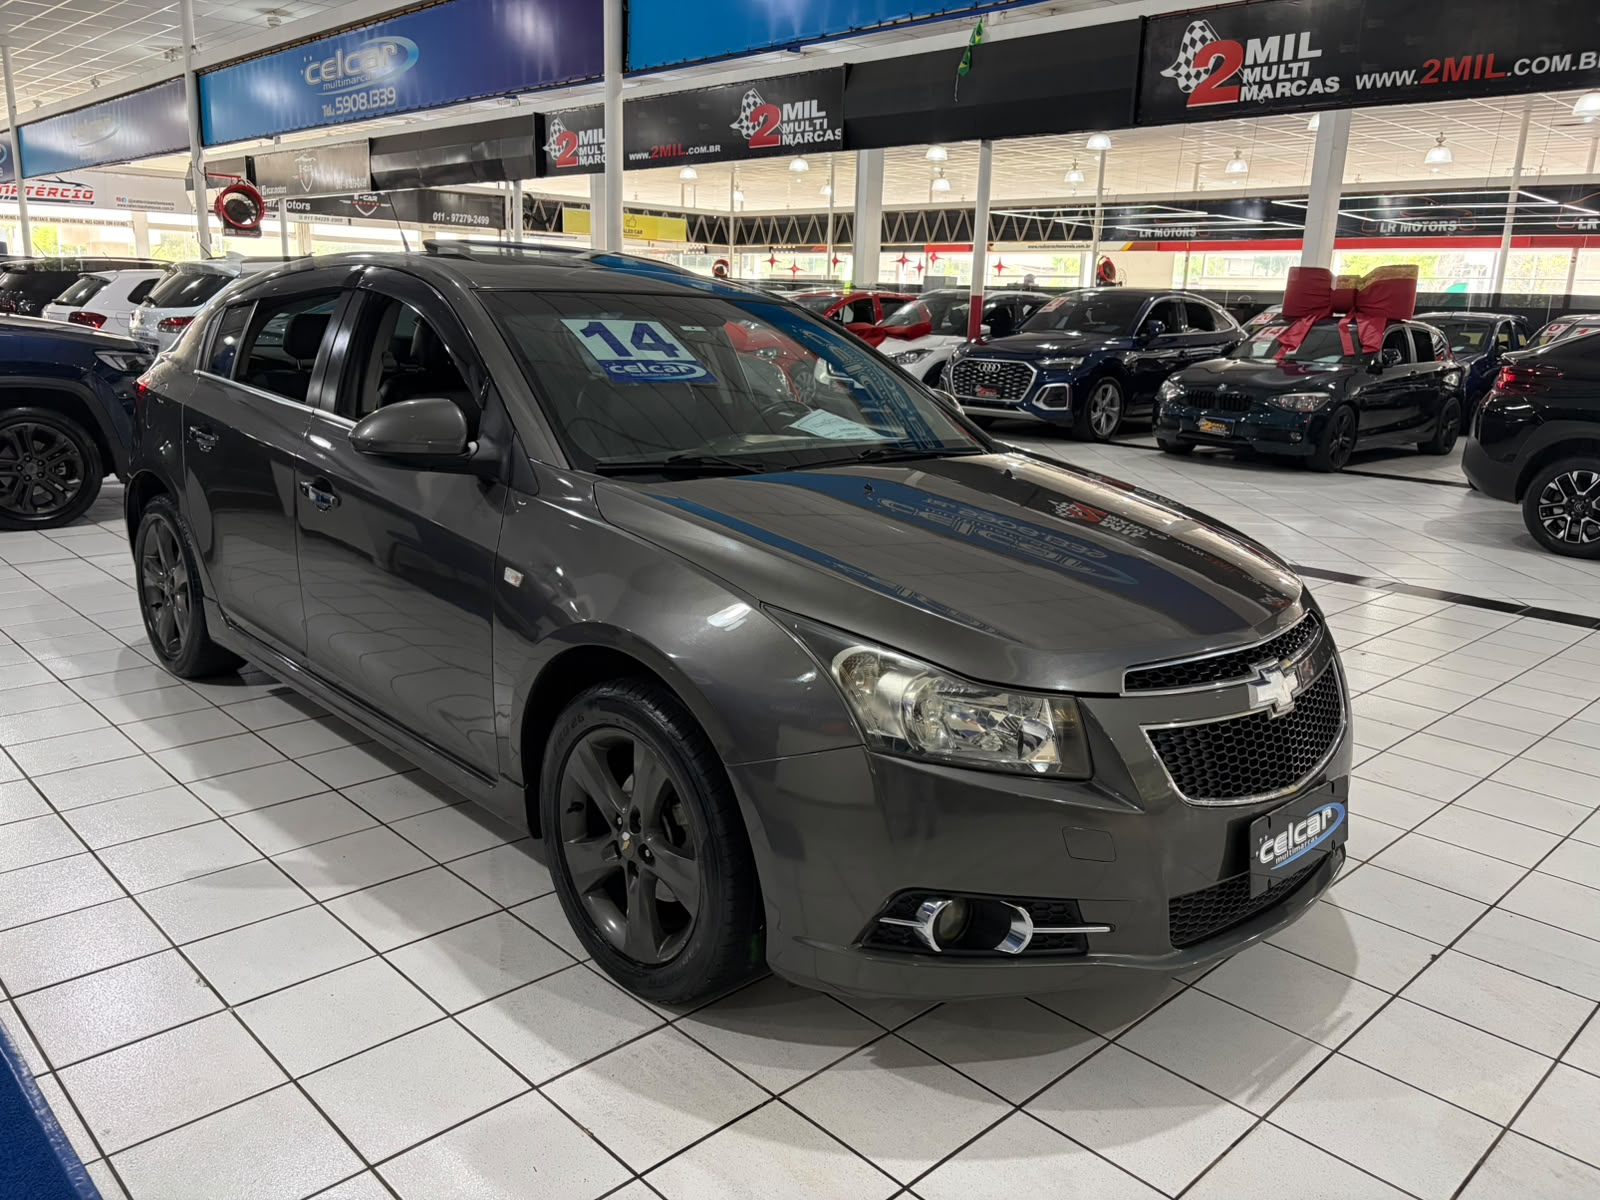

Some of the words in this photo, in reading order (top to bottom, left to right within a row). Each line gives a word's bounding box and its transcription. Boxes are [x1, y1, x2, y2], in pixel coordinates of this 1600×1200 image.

[305, 43, 398, 86] celcar
[1186, 39, 1244, 108] 2
[1244, 31, 1323, 66] MIL
[1242, 61, 1310, 84] MULTI
[1355, 51, 1600, 90] WWW.2MIL.COM.B
[1239, 76, 1341, 103] MARCAS
[749, 104, 781, 149] 2
[782, 99, 826, 121] MIL
[782, 118, 828, 134] MULTI
[556, 130, 579, 168] 2
[782, 128, 842, 146] MARCAS
[432, 211, 445, 221] 011
[1380, 221, 1396, 233] LR
[1400, 220, 1458, 233] MOTORS
[1577, 217, 1599, 230] LR
[1155, 227, 1197, 238] MOTORS
[579, 321, 680, 358] 14
[609, 362, 690, 373] celcar
[1260, 806, 1332, 864] celcar
